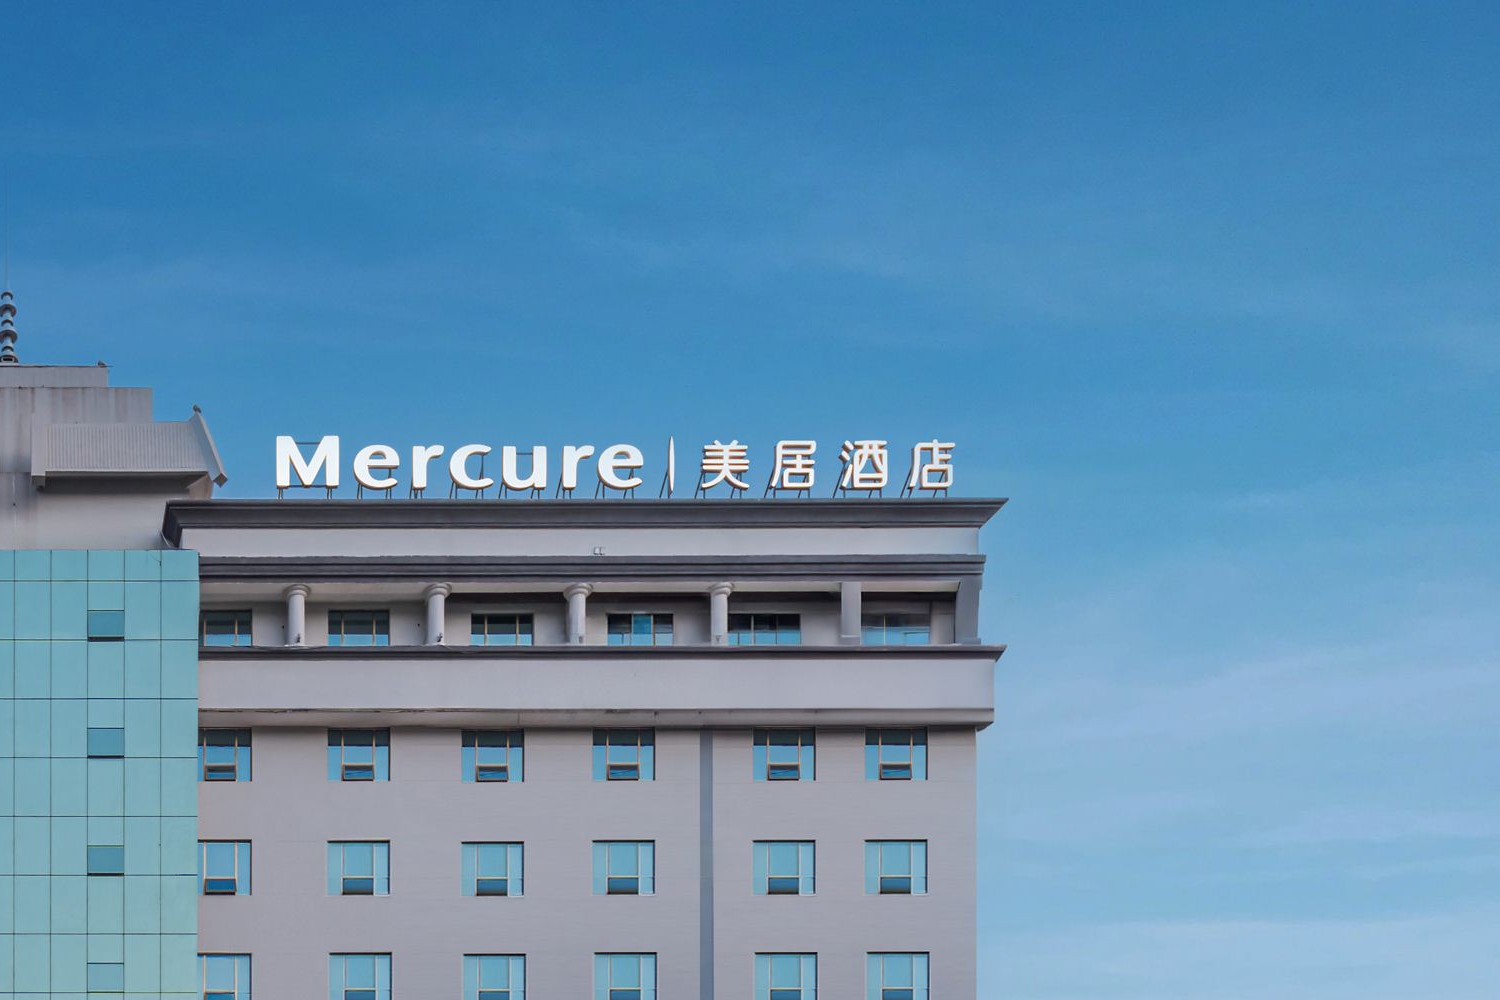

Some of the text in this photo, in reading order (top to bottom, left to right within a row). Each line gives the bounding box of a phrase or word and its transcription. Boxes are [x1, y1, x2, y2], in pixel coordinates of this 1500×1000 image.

[276, 435, 956, 490] Mercure 美居酒店
